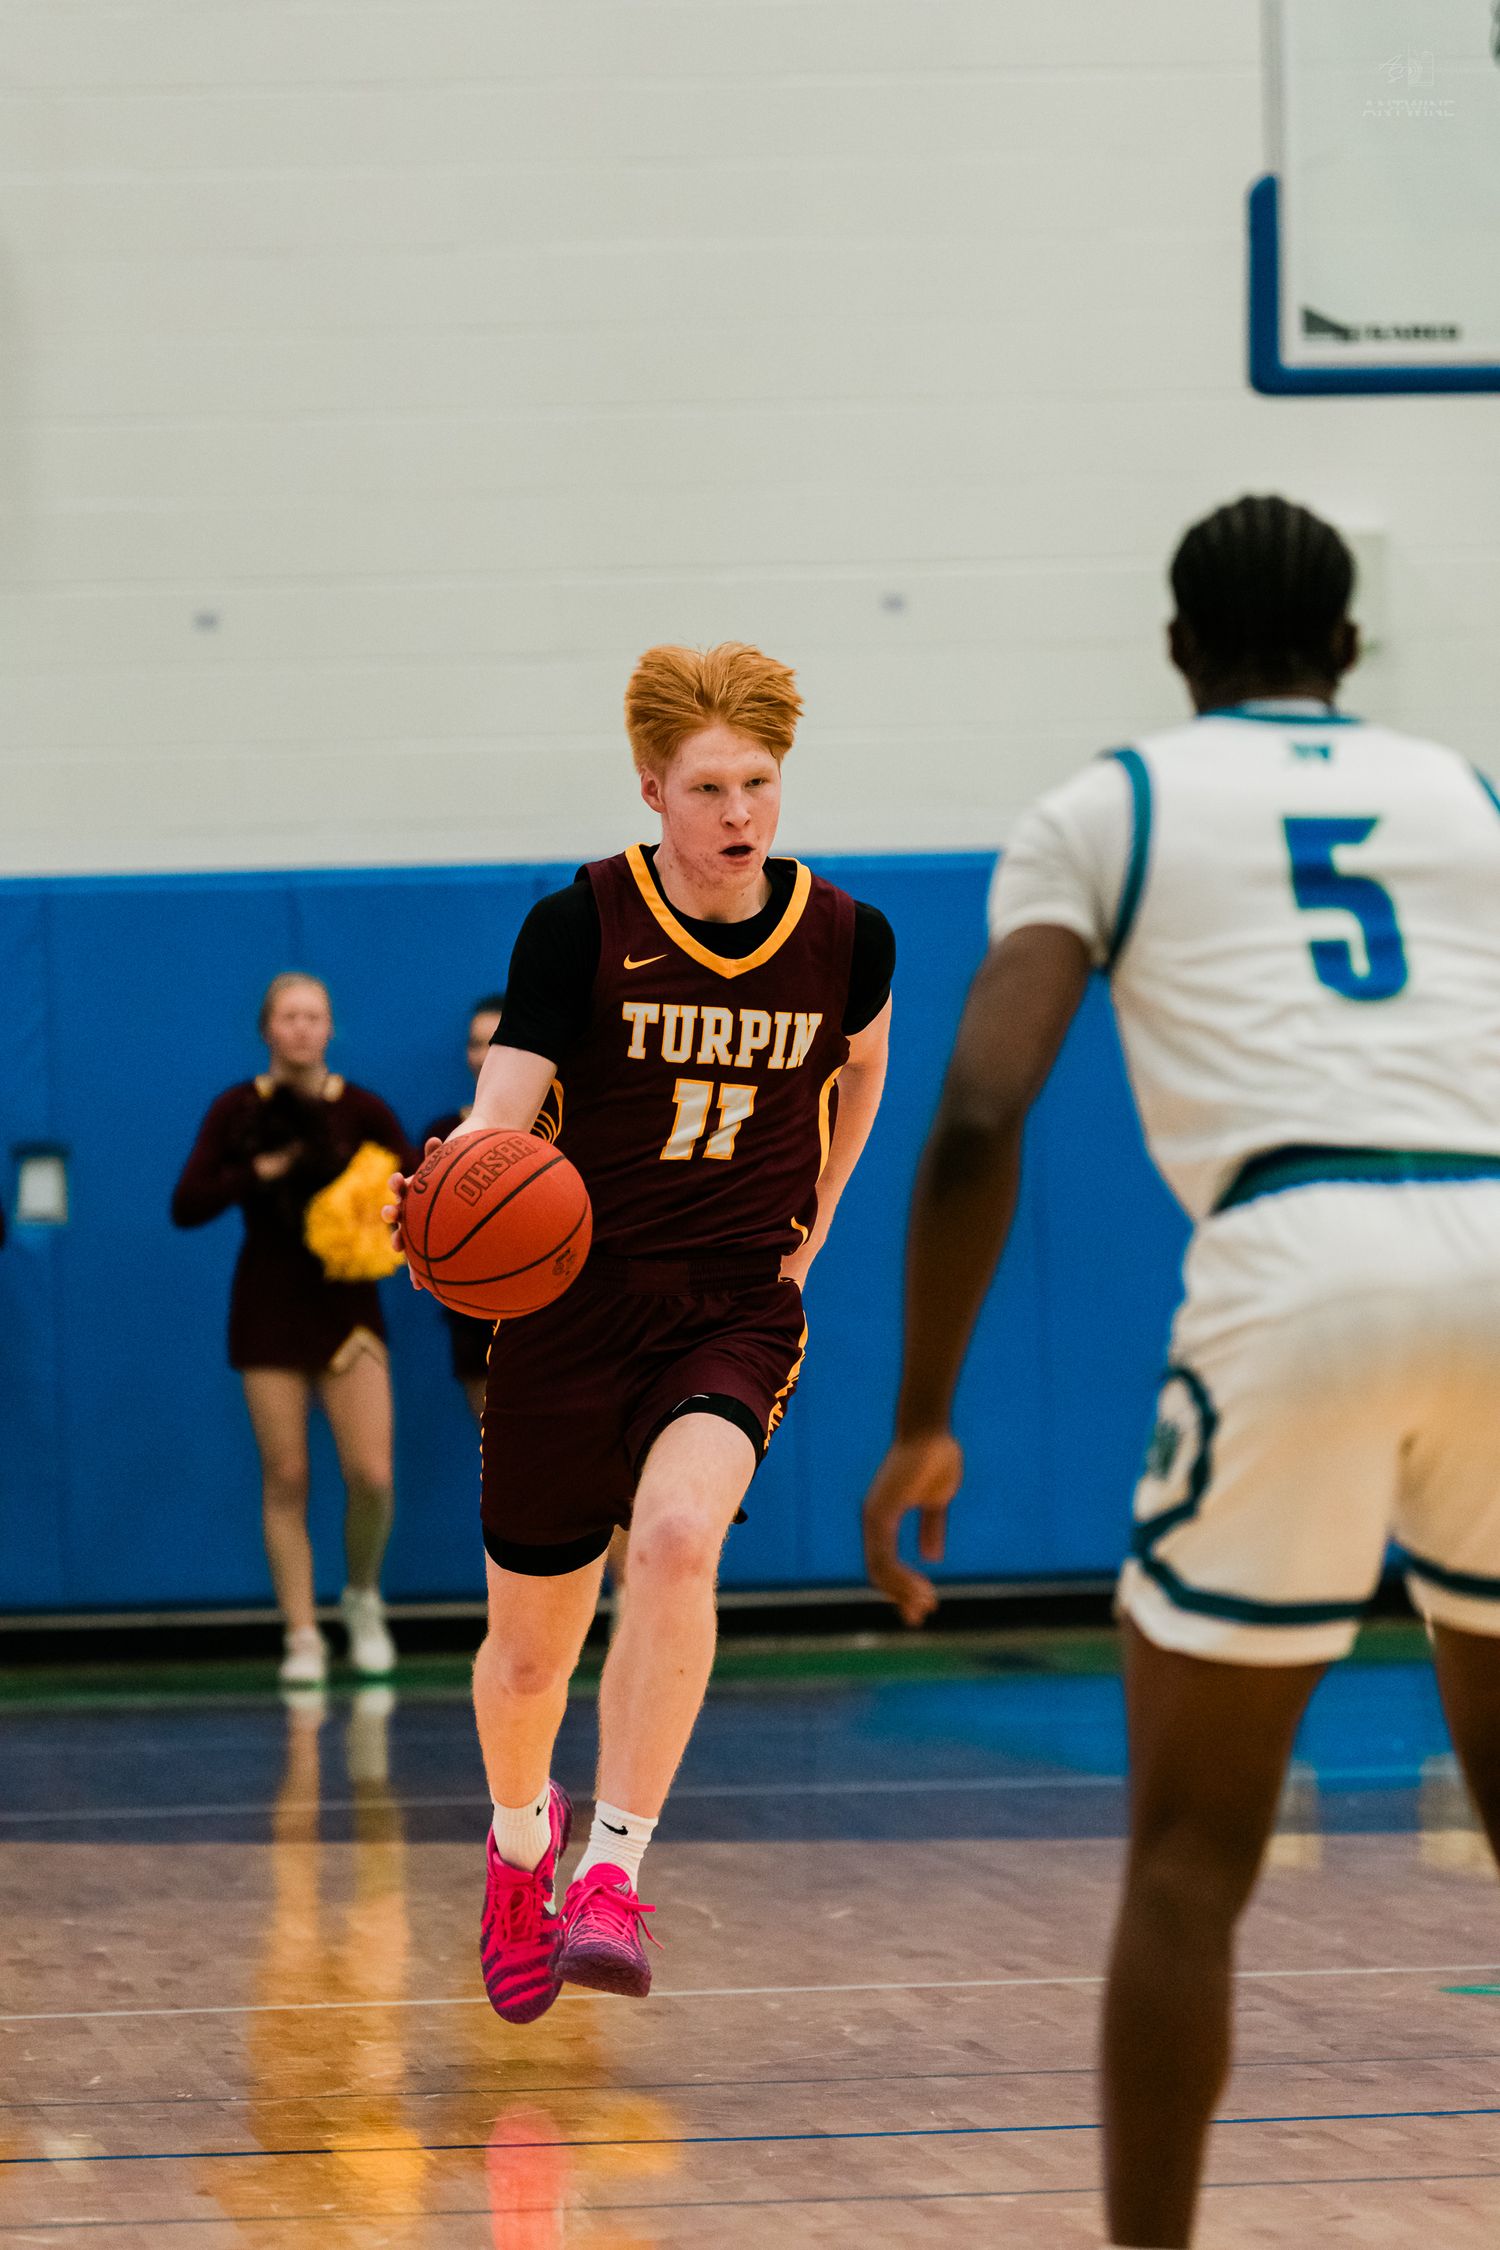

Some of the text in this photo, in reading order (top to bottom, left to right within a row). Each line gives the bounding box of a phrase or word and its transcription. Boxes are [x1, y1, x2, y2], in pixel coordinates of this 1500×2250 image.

[1282, 815, 1408, 1001] 5
[622, 1002, 823, 1070] TURPIN
[659, 1078, 758, 1161] 11
[454, 1136, 539, 1207] OHSAA
